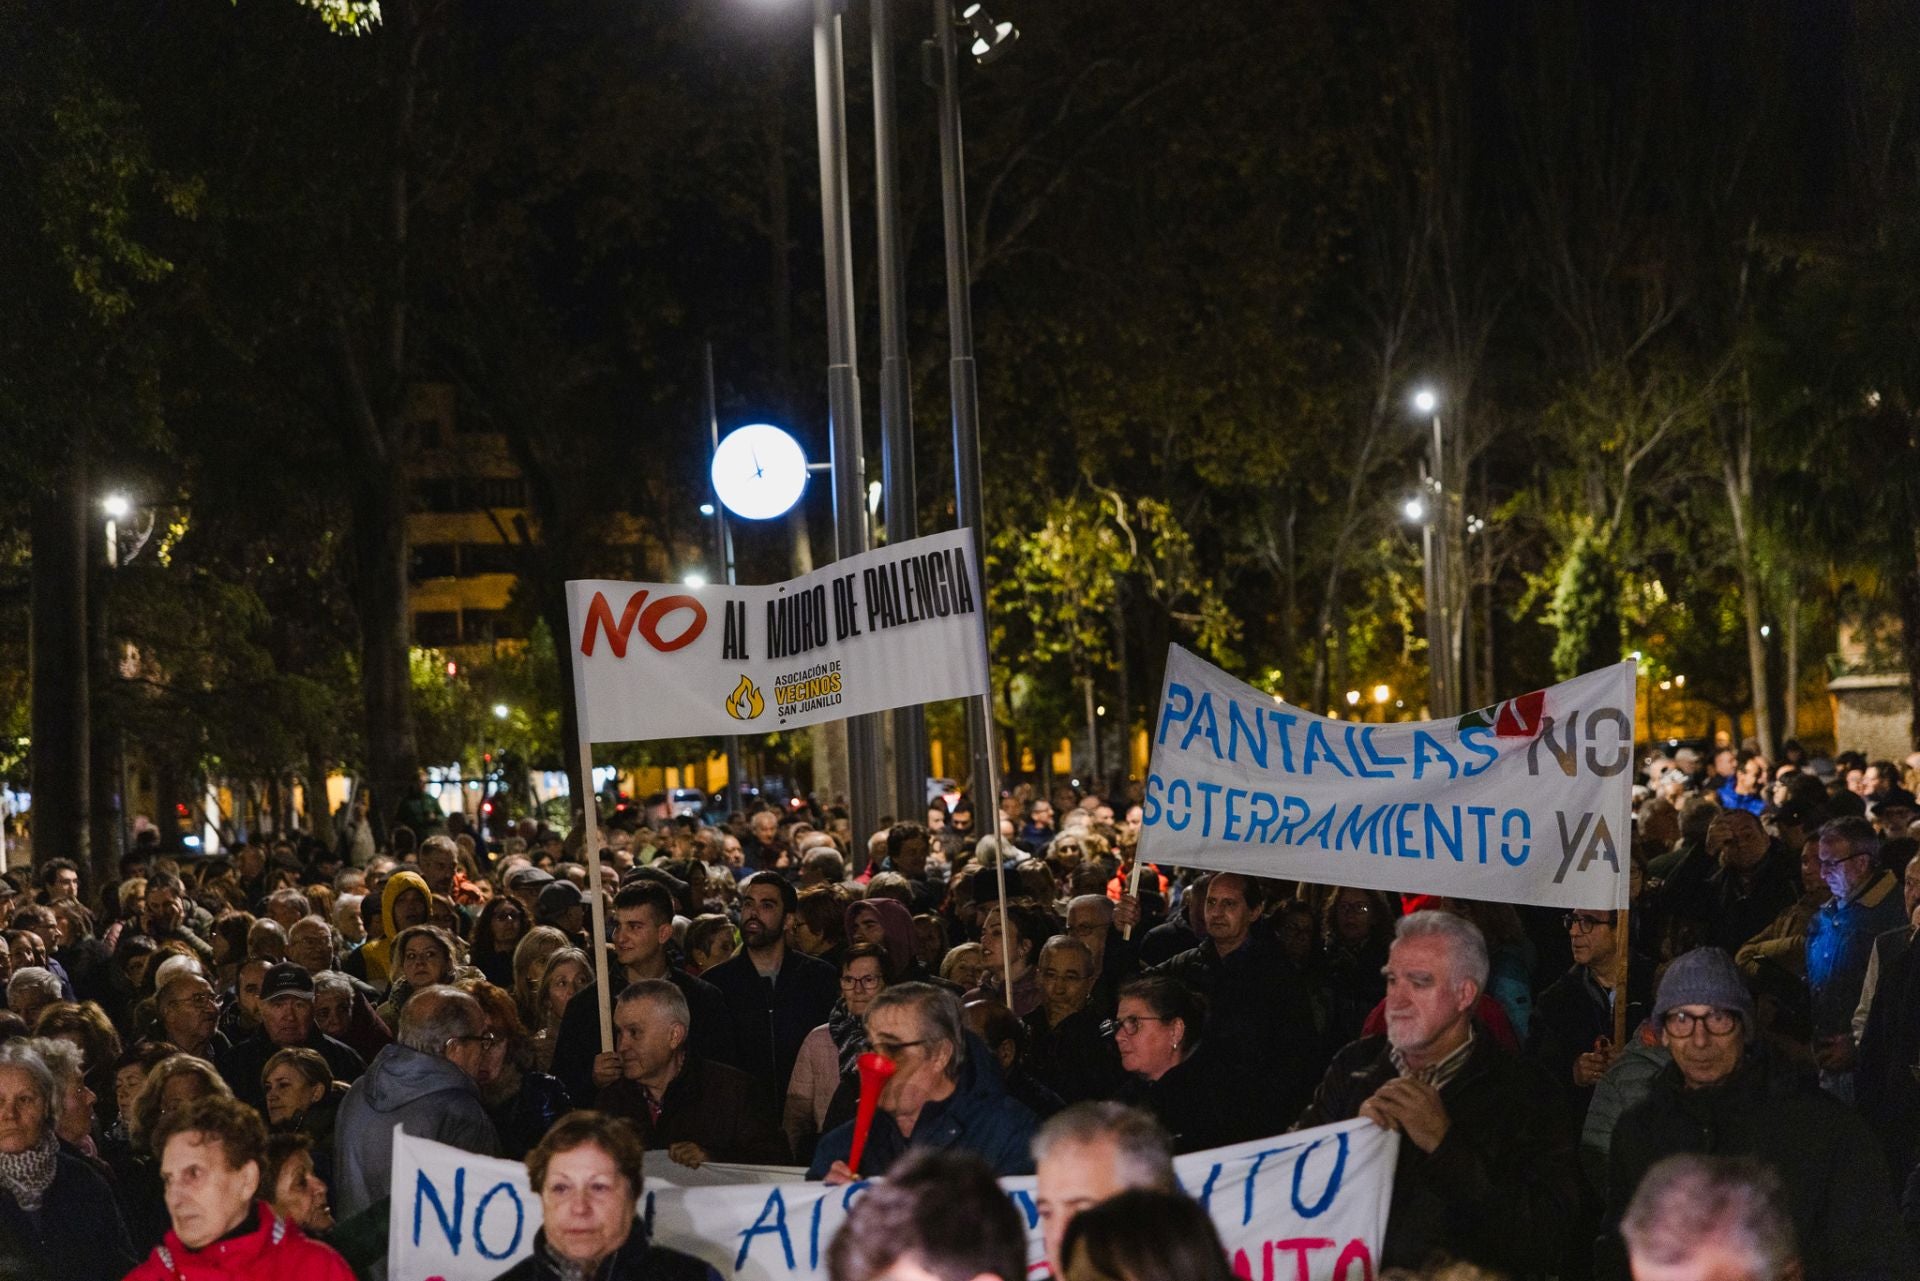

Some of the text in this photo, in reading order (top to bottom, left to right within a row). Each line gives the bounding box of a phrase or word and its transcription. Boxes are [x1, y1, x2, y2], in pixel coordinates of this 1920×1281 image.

[581, 547, 975, 660] NO AL MURO DE PALENCIA
[774, 672, 842, 705] VECINOS
[775, 660, 842, 686] ASOCIACIÓN DE
[778, 693, 842, 717] SAN JUANILLO
[1159, 682, 1498, 779] PANTALLAS
[1528, 707, 1631, 777] NO
[1143, 774, 1620, 884] SOTERRAMIENTO YA
[413, 1167, 524, 1260] NO
